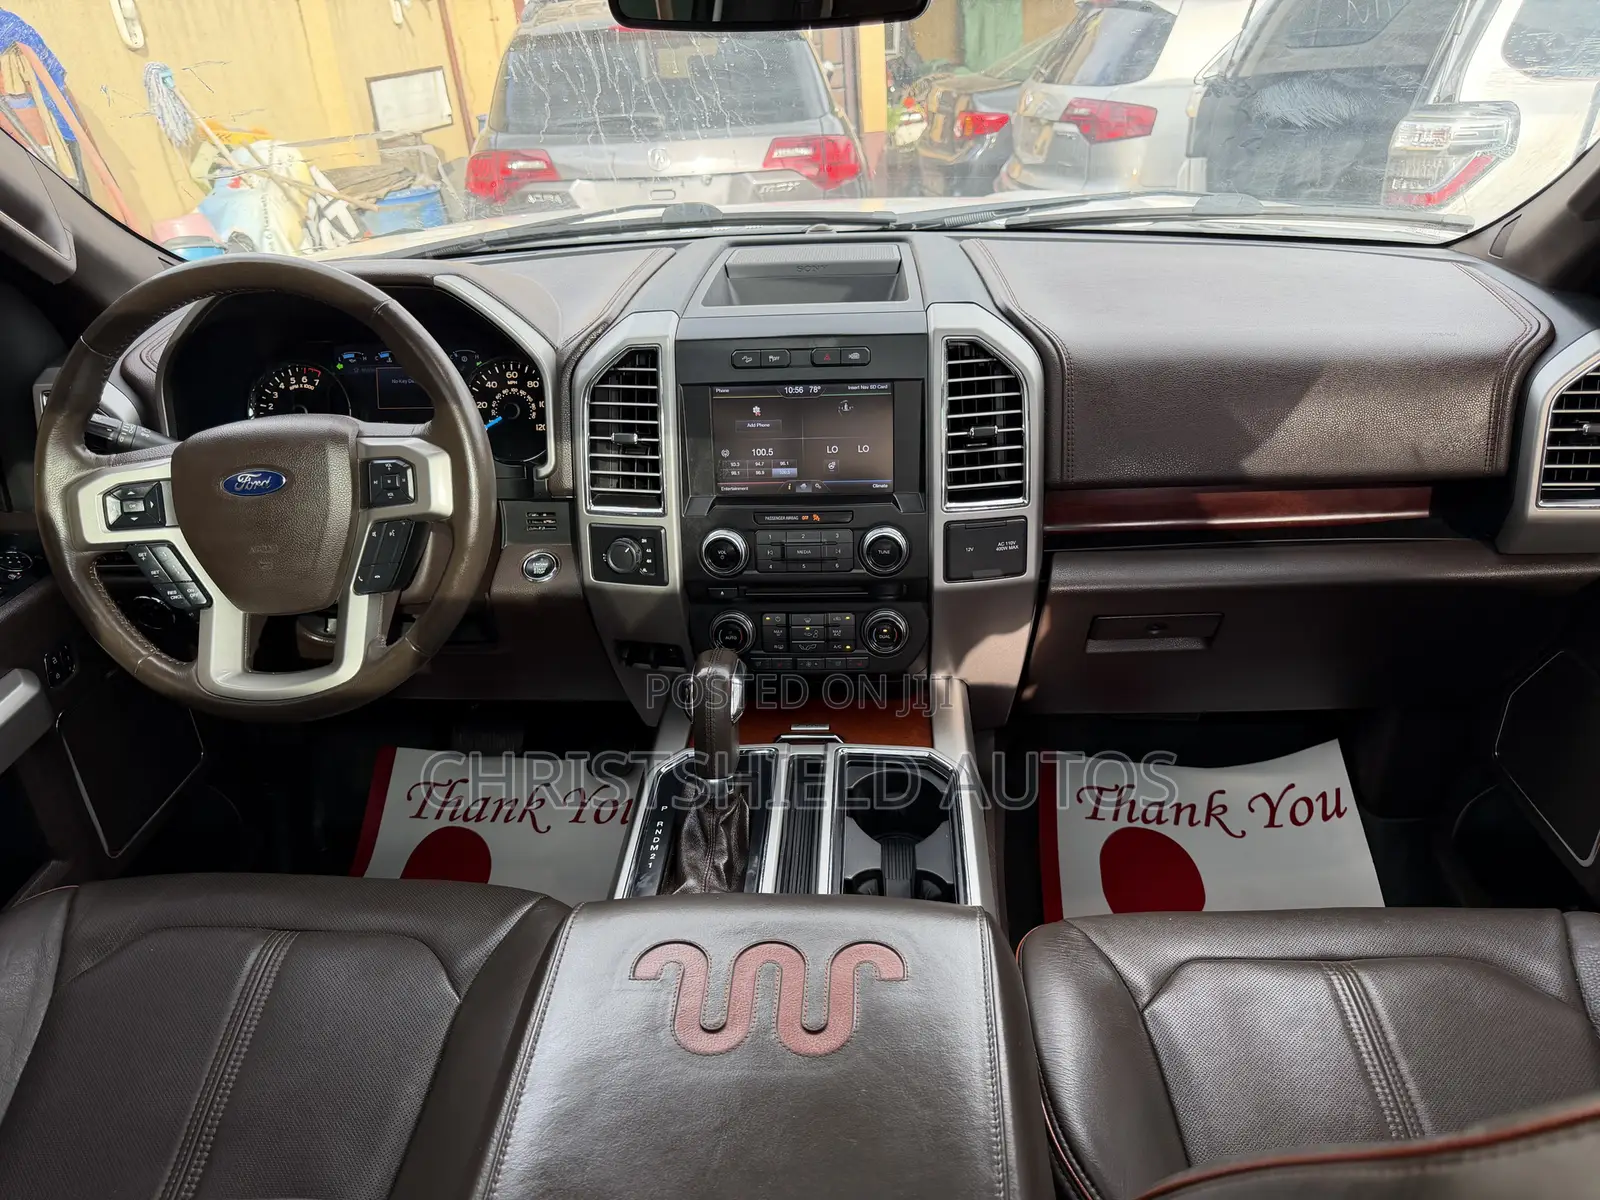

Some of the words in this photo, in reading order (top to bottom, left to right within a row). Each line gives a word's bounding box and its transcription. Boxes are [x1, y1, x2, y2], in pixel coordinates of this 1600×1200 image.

[797, 264, 828, 272] SONY
[784, 386, 804, 394] 10:56
[752, 448, 774, 456] 100.5
[826, 446, 838, 454] LO
[858, 444, 870, 452] LO
[235, 473, 272, 490] Ford
[406, 778, 551, 834] Thank
[1076, 784, 1246, 838] Thank
[1248, 783, 1348, 828] You
